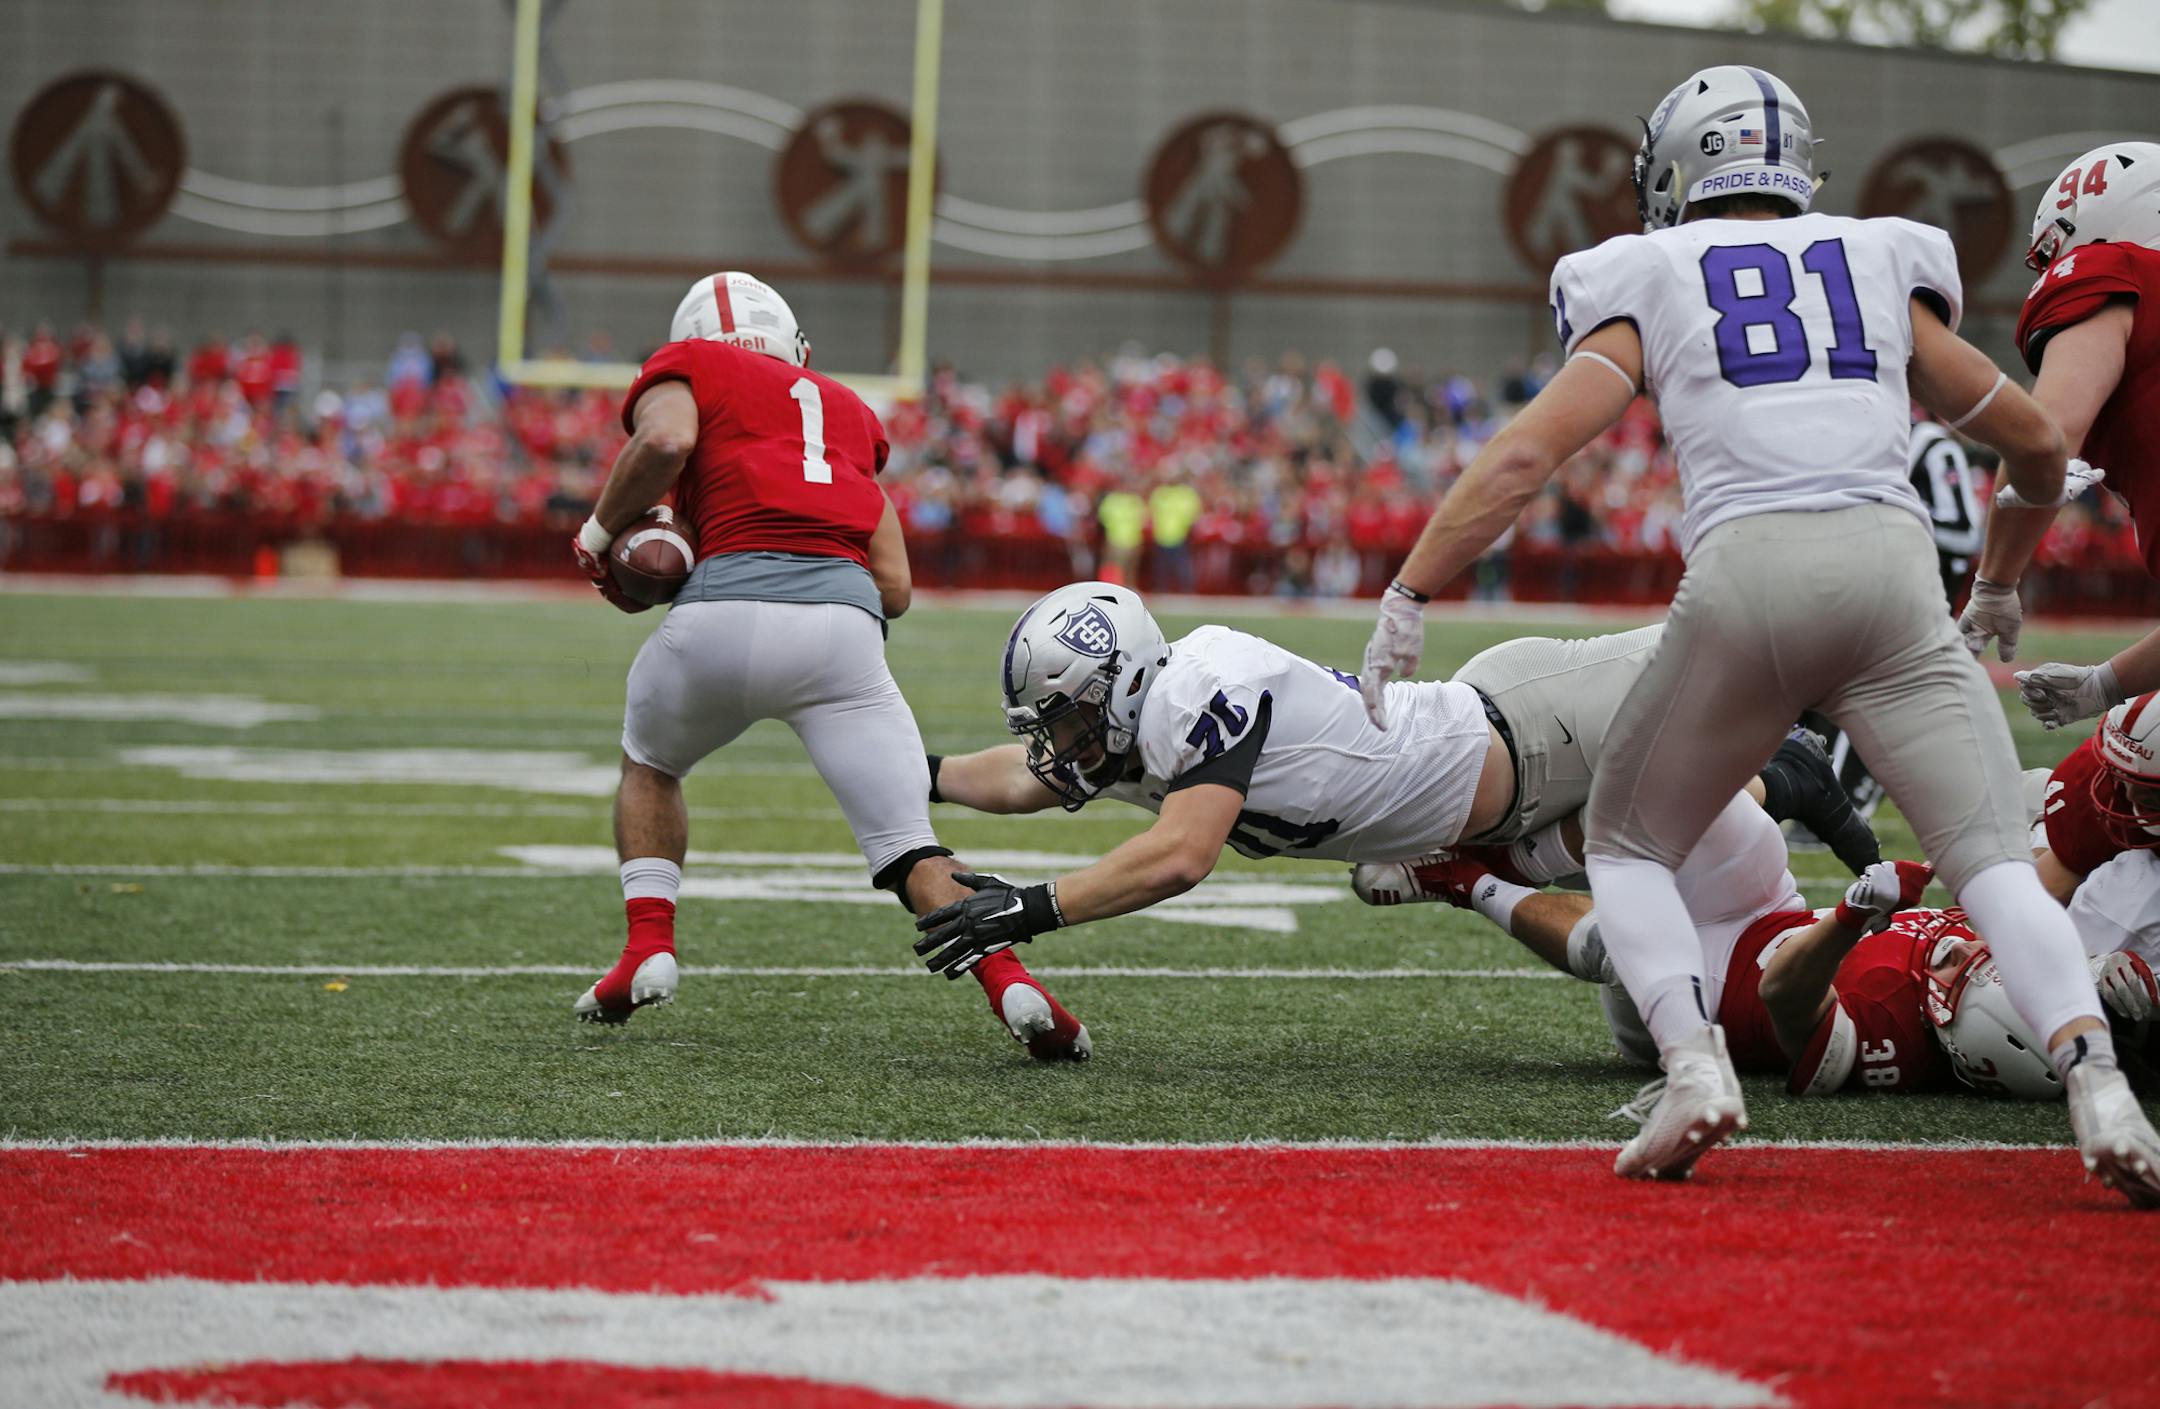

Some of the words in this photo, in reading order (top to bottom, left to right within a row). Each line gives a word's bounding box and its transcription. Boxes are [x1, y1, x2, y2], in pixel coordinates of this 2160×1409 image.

[1703, 134, 1723, 153] JG
[1783, 132, 1793, 150] 81
[1702, 172, 1756, 195] PRIDE
[1758, 172, 1770, 187] &
[1773, 173, 1812, 199] PASSIO
[2056, 159, 2109, 211] 94
[1700, 237, 1879, 389] 81
[727, 336, 766, 350] dell
[789, 377, 833, 485] 1
[1862, 1038, 1900, 1087] 38
